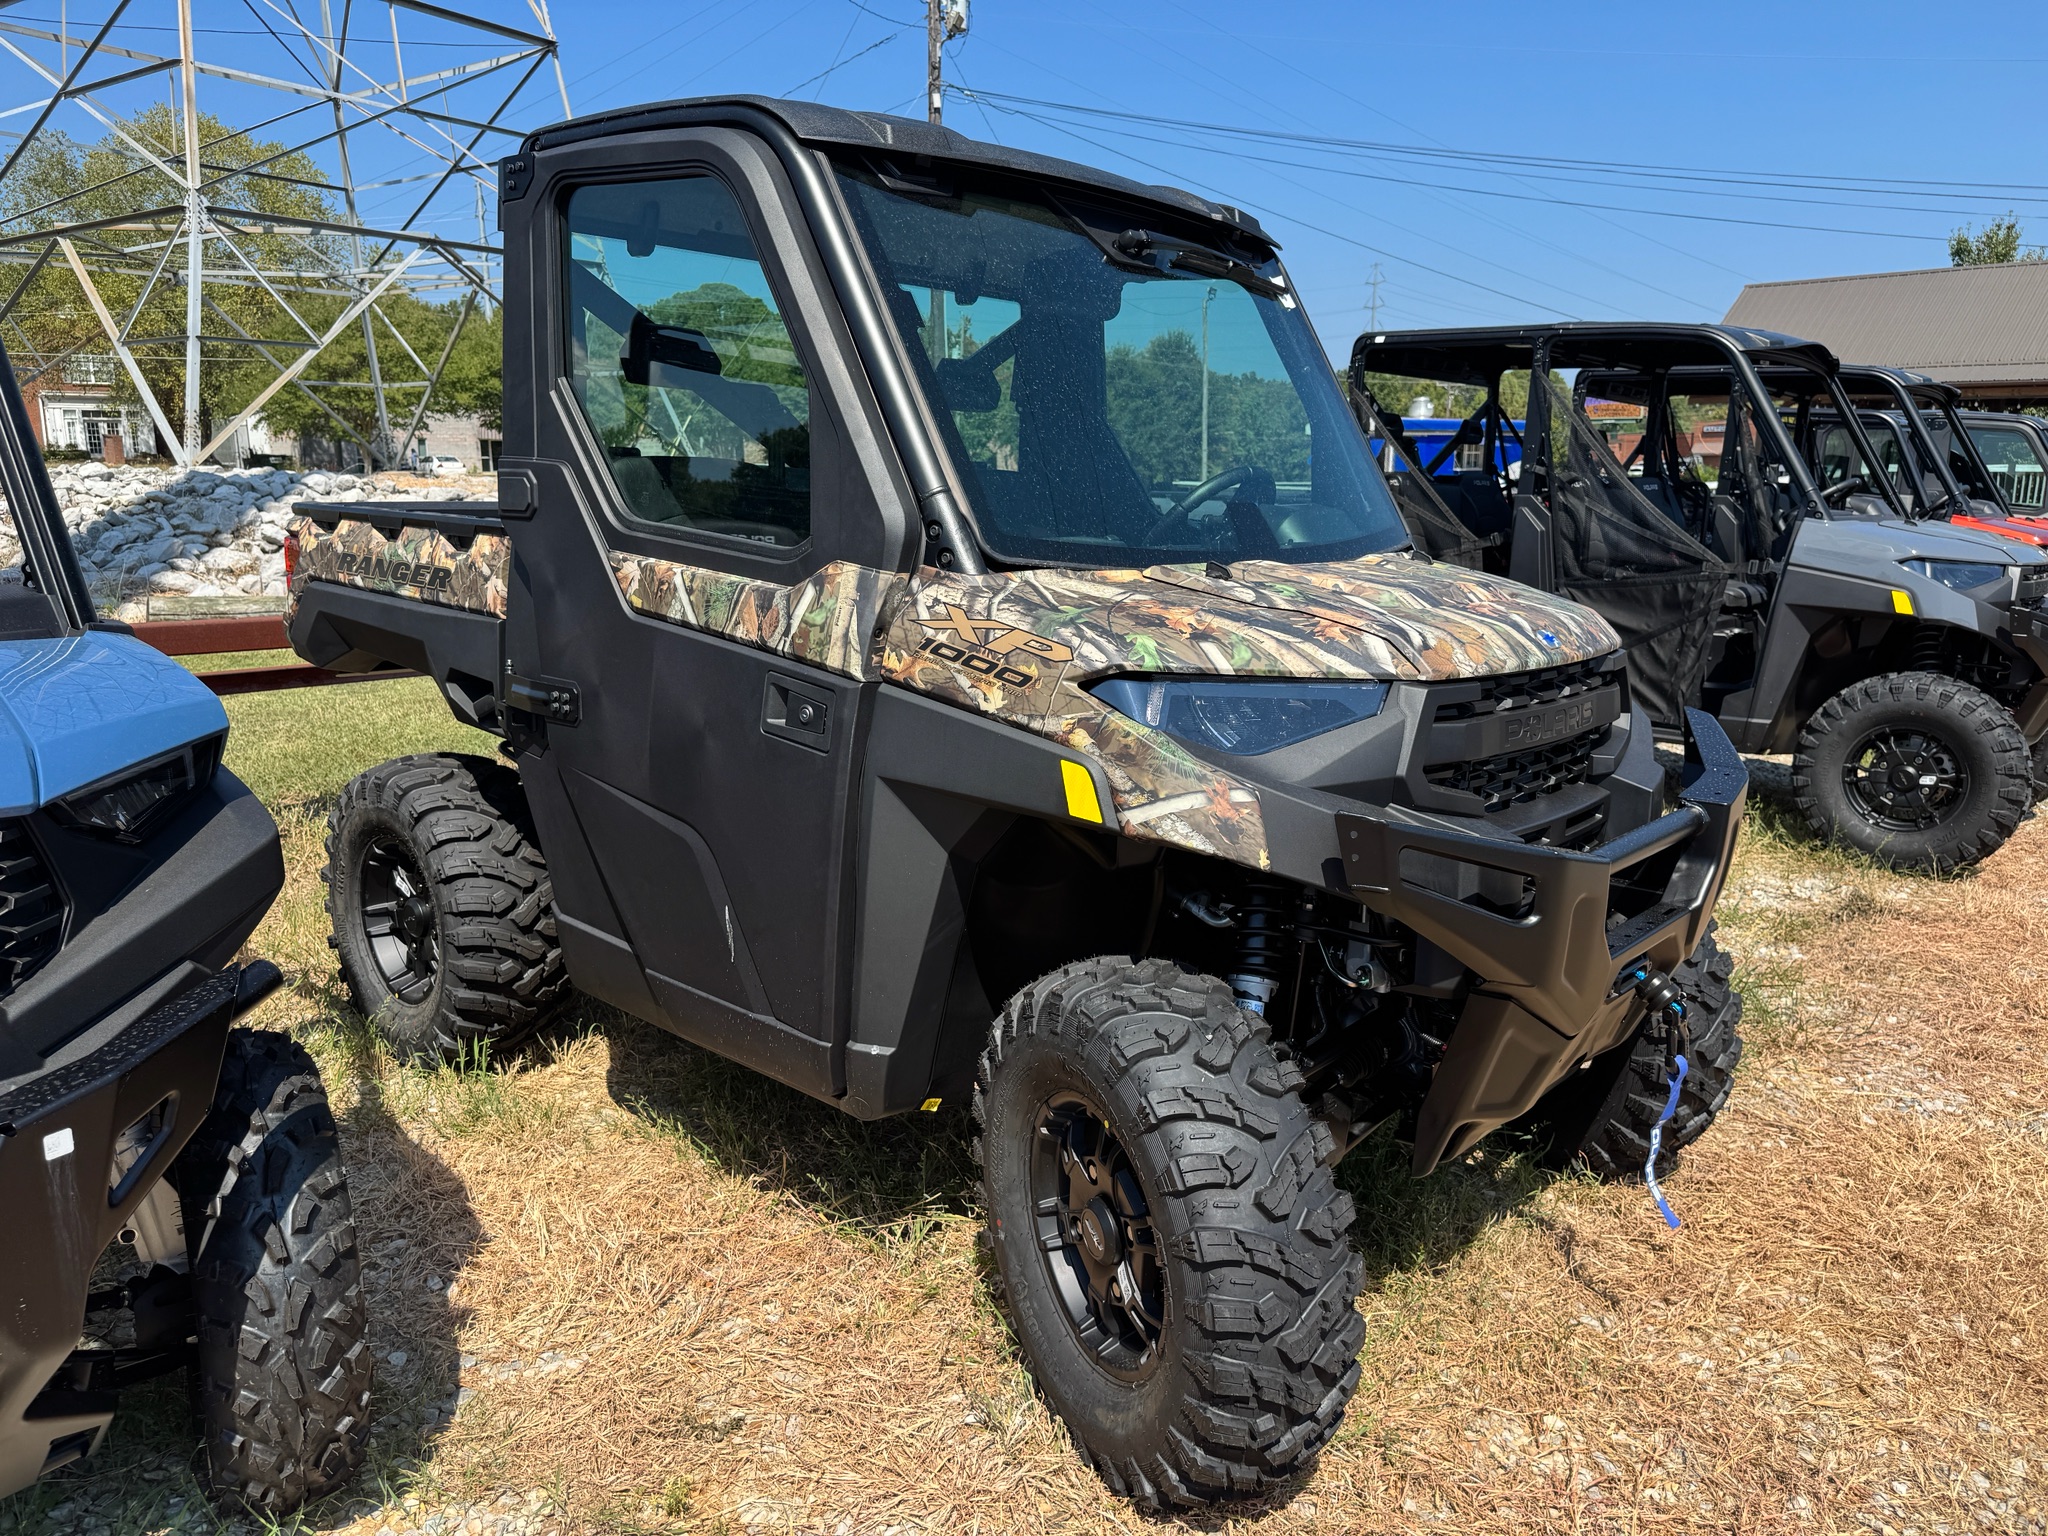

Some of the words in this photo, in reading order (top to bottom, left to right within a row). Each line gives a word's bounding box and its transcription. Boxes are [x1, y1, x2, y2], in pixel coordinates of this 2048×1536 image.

[336, 553, 451, 590] RANGER
[908, 602, 1074, 662] XP
[917, 637, 1034, 689] 1000
[1504, 701, 1594, 748] POLARIS
